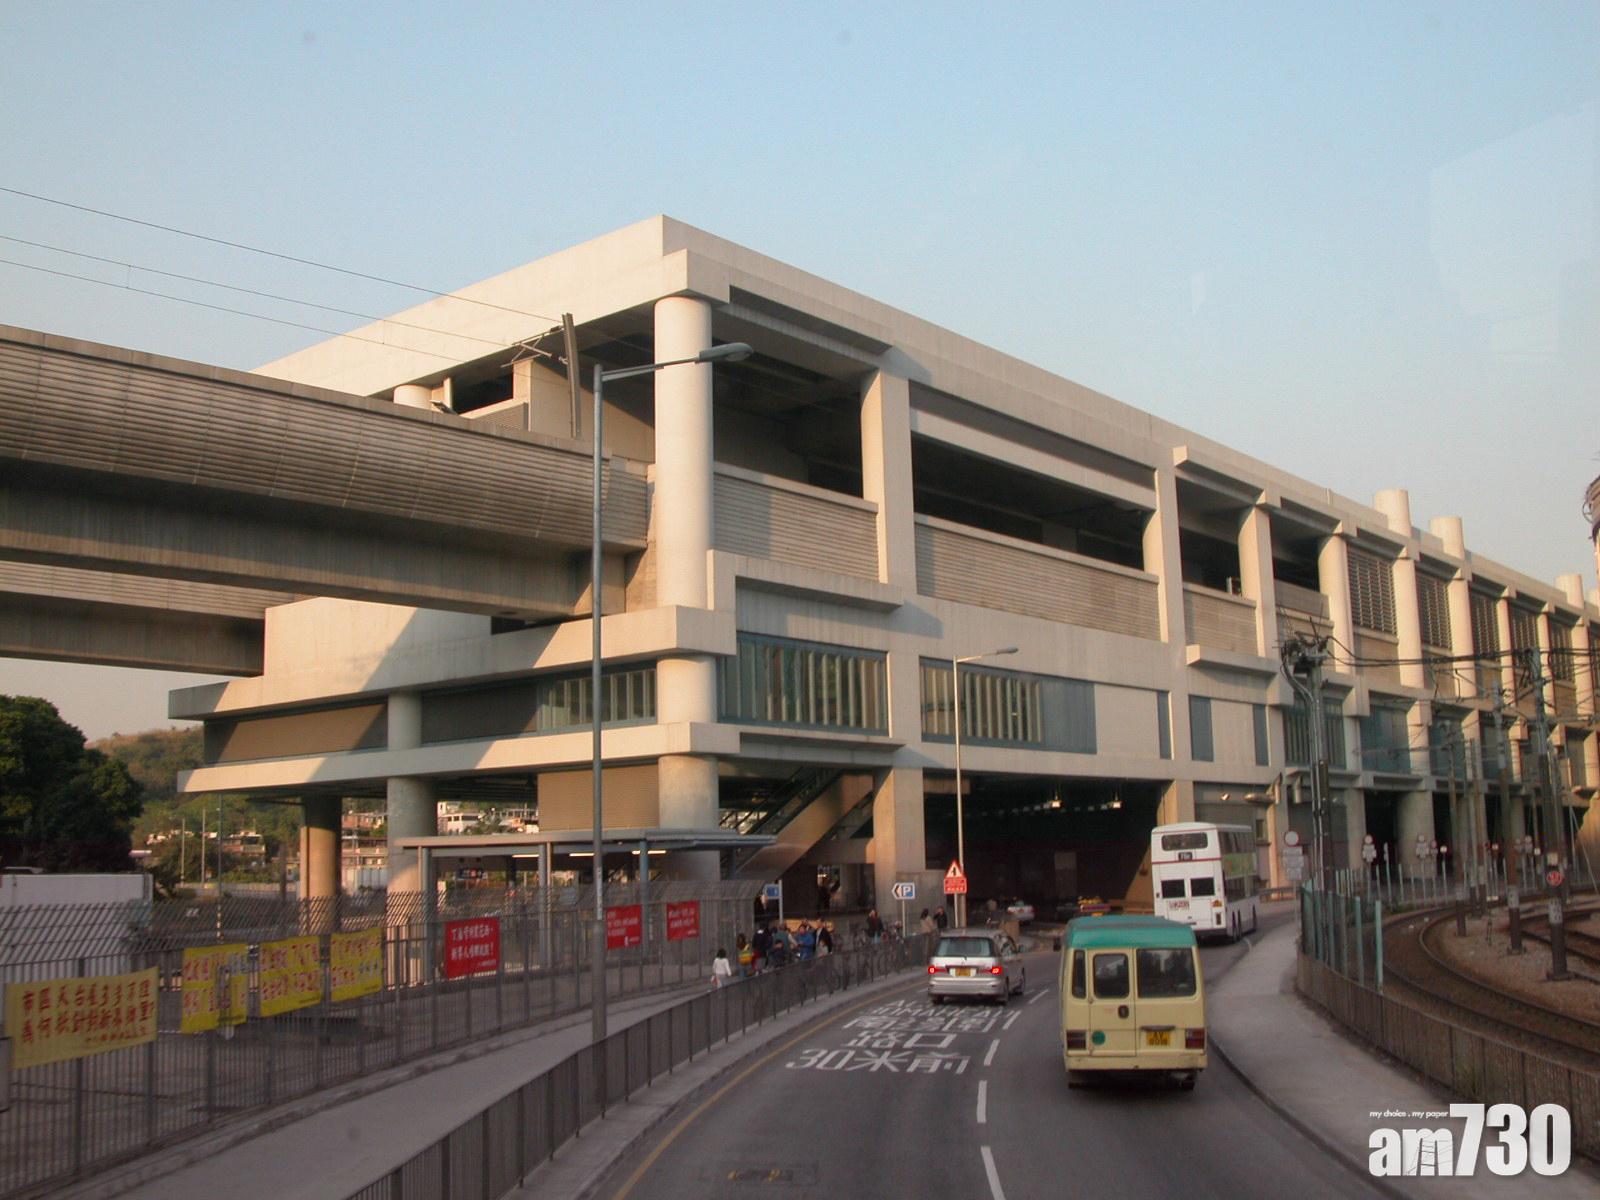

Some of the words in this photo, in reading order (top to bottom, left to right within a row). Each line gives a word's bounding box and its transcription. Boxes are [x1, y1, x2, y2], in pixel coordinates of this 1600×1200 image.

[902, 886, 912, 896] P
[842, 1030, 957, 1049] 路口
[785, 1047, 971, 1075] 30米前
